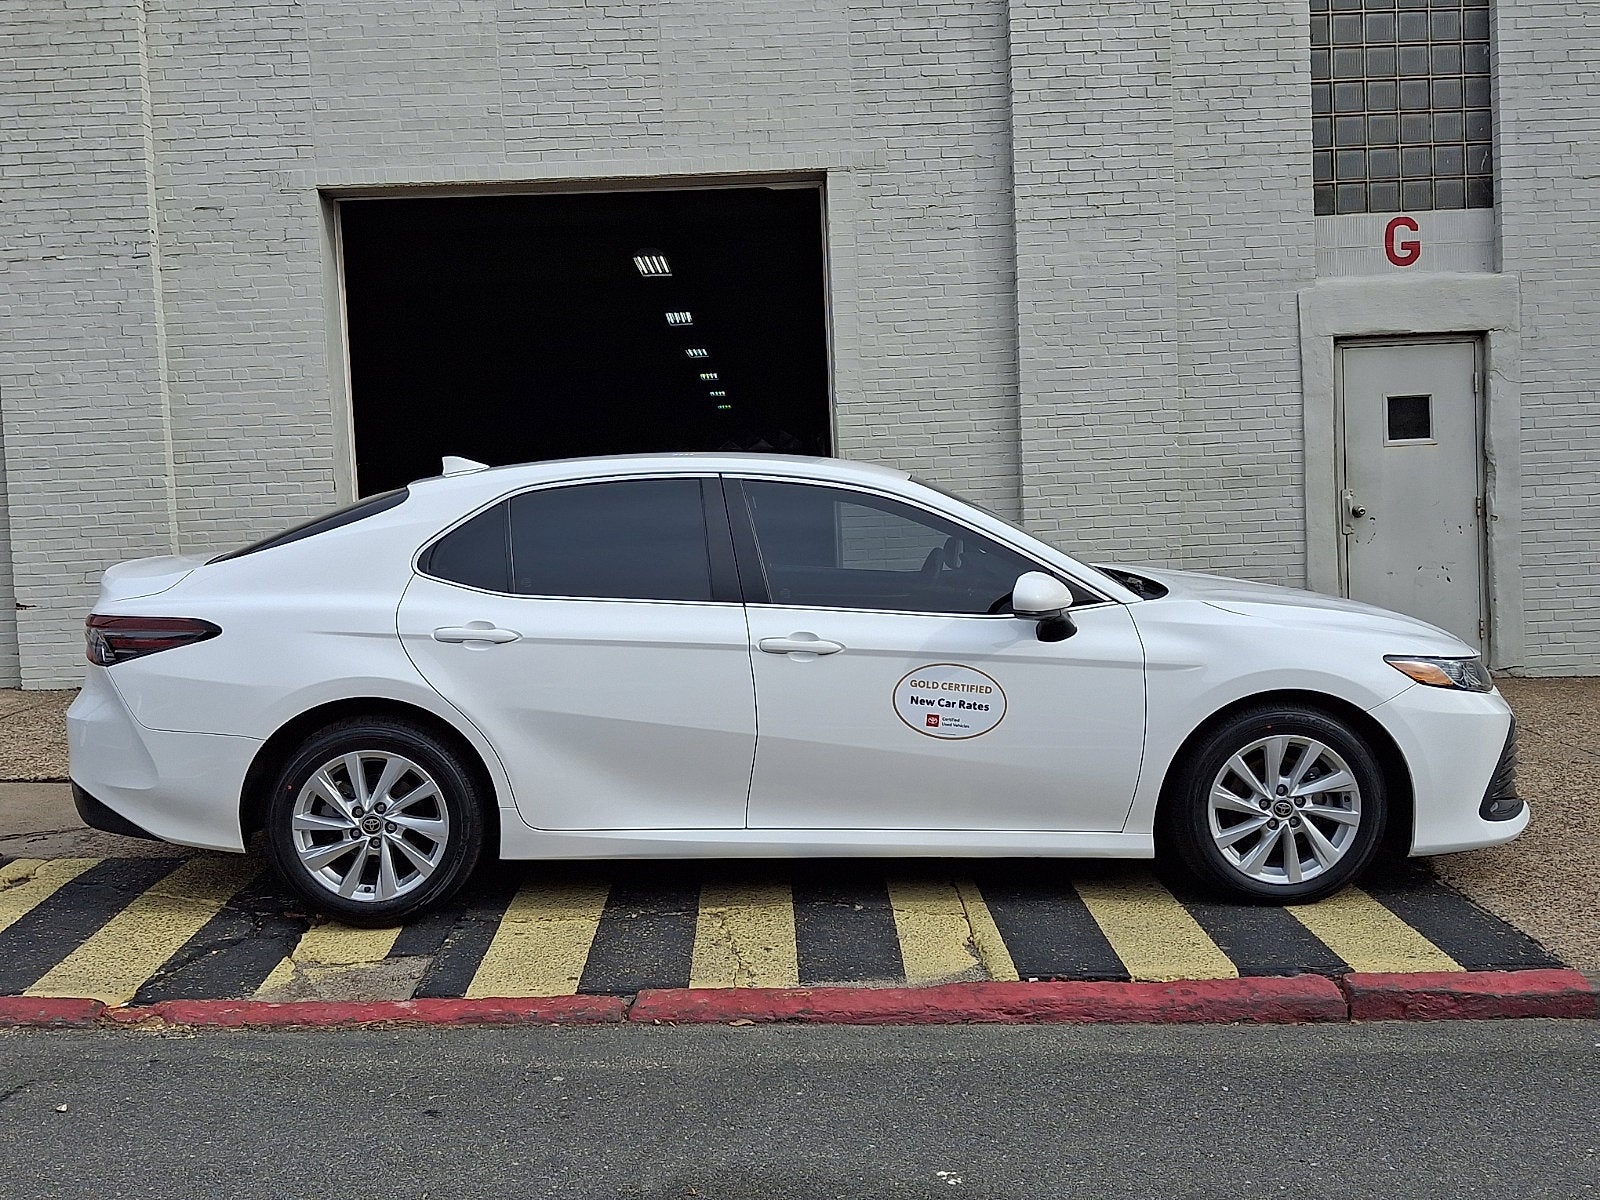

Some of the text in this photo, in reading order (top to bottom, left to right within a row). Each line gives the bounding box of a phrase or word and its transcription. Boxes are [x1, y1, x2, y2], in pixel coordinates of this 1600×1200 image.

[1385, 216, 1421, 266] G
[910, 680, 993, 694] GOLD CERTIFIED
[910, 696, 990, 711] New Car Rates
